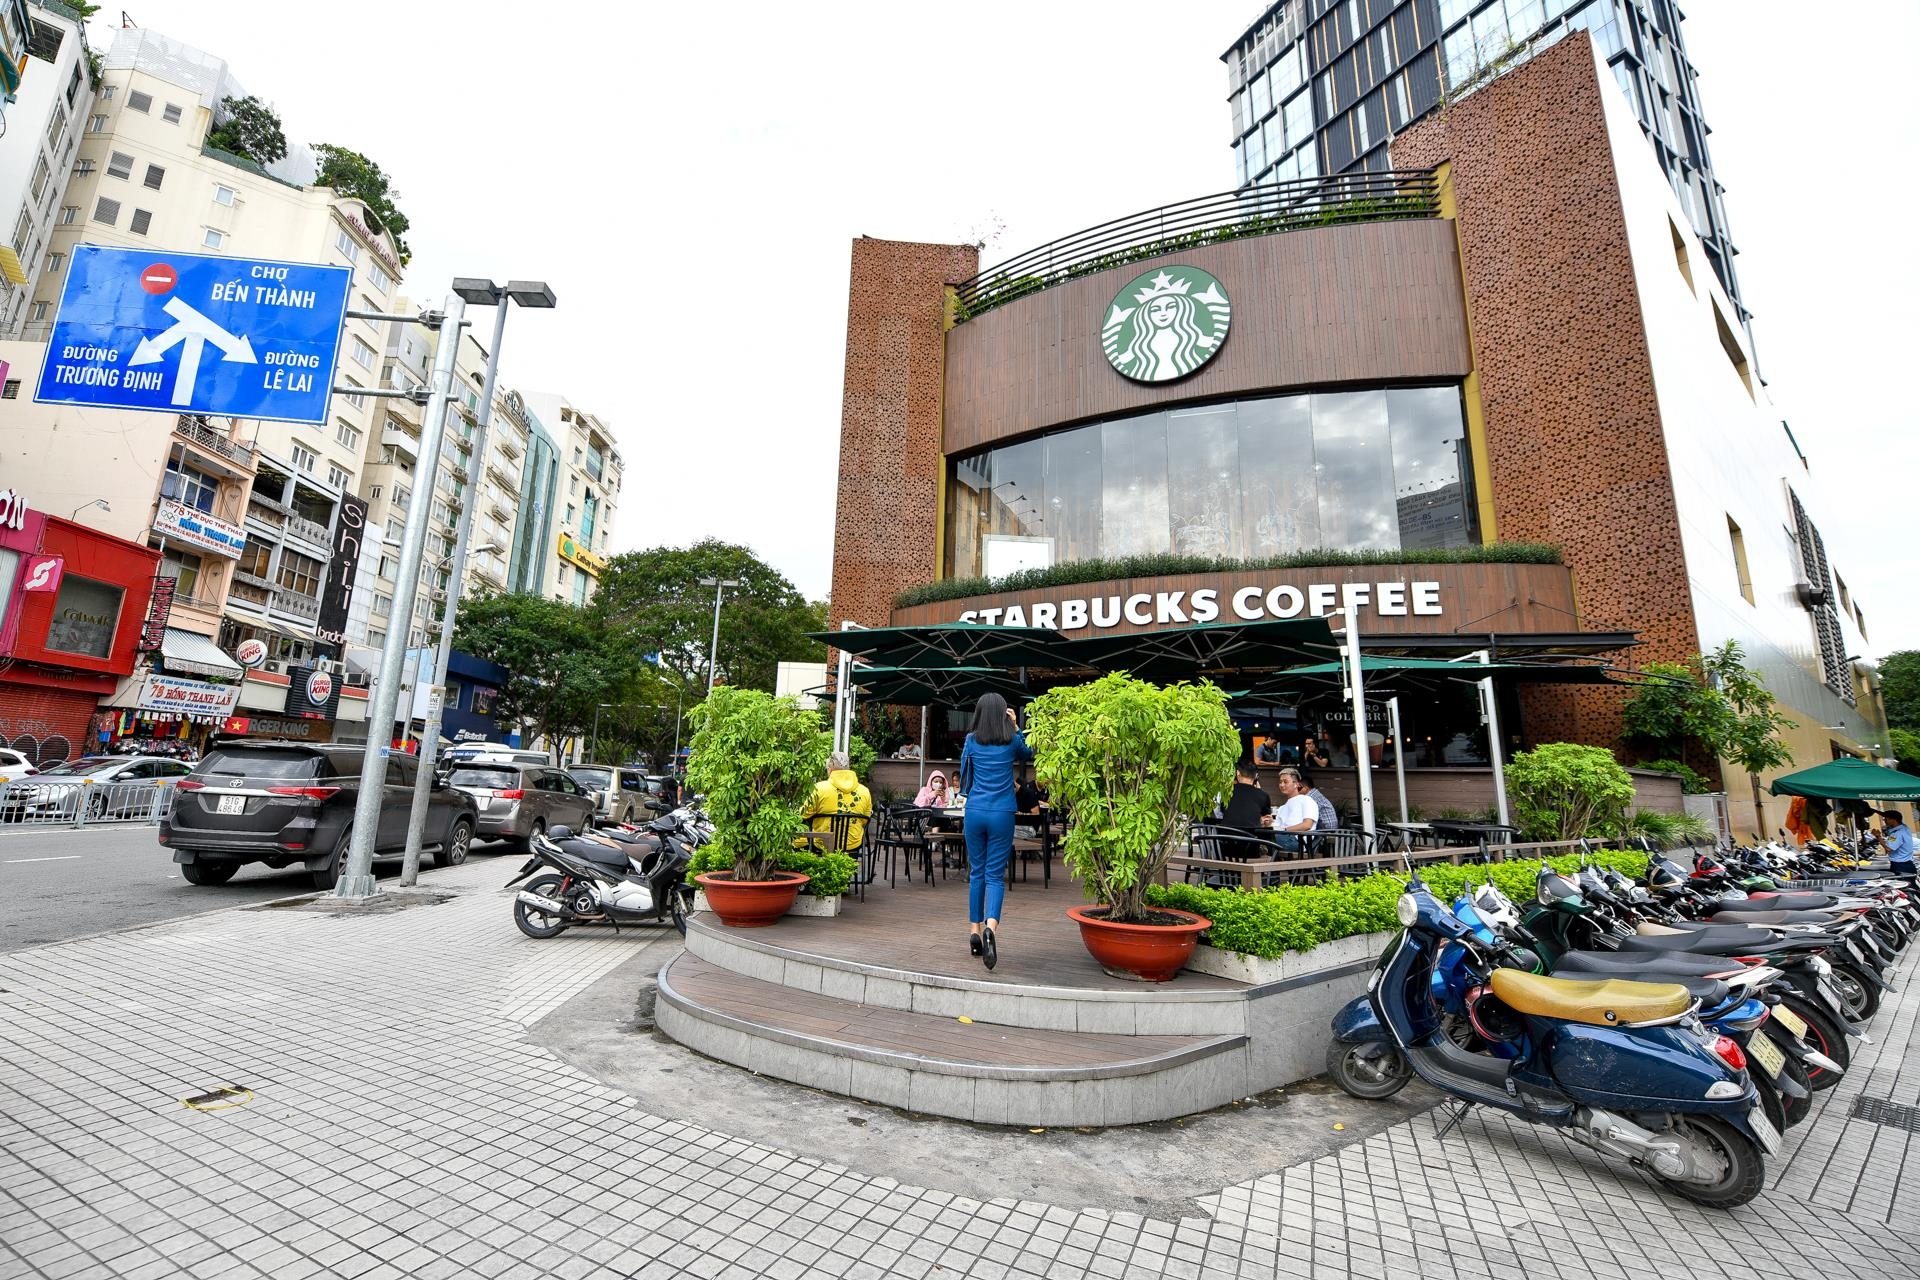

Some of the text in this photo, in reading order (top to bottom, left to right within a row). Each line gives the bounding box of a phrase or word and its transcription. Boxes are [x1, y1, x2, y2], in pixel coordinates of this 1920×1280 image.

[251, 265, 289, 282] CHỢ
[212, 278, 316, 309] BẾN THÀNH
[63, 345, 118, 362] ĐƯỜNG
[264, 351, 320, 368] ĐƯỜNG
[55, 364, 163, 392] TRƯƠNG ĐỊNH
[263, 370, 313, 393] LÊ LAI
[958, 581, 1443, 631] STARBUCKS COFFEE
[240, 647, 261, 661] KING
[150, 684, 165, 698] 78
[188, 691, 215, 704] THANH
[215, 695, 233, 706] LAN
[312, 685, 331, 694] KING
[1347, 704, 1379, 712] NRO
[248, 718, 310, 736] RGER KING
